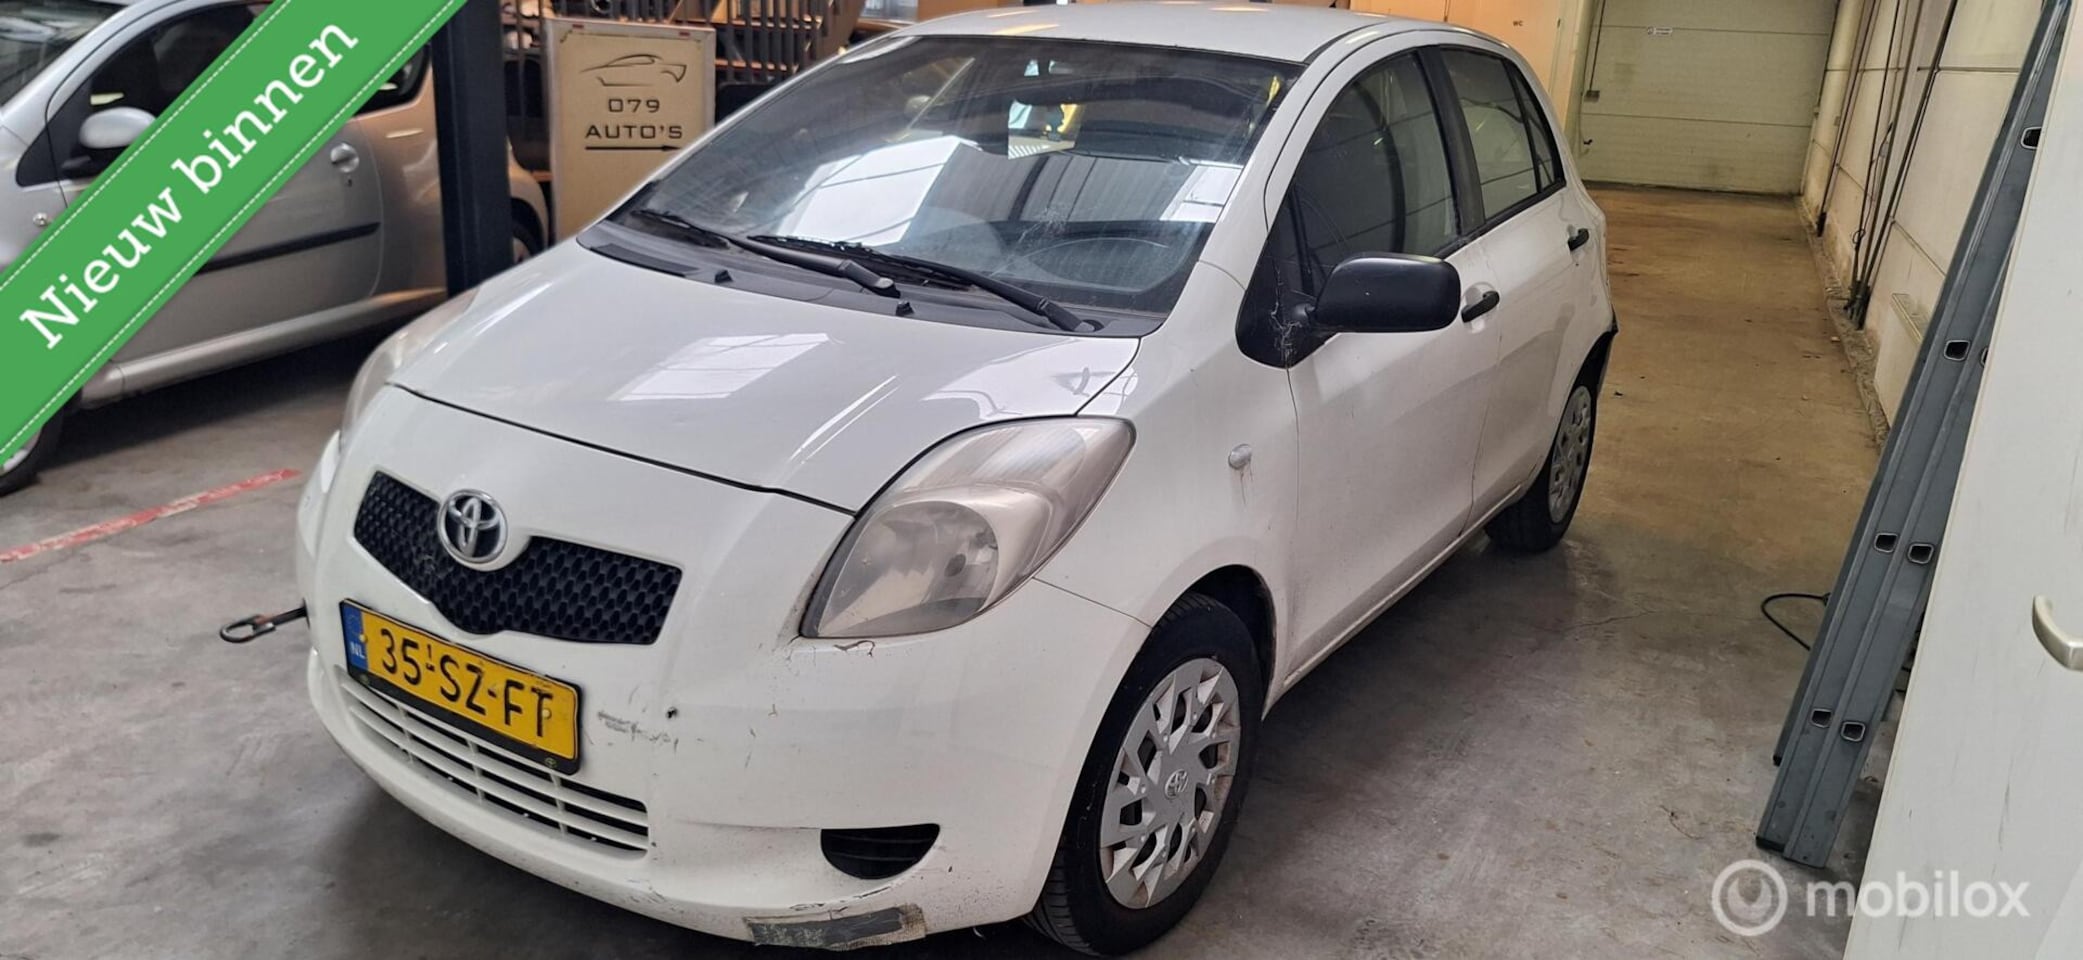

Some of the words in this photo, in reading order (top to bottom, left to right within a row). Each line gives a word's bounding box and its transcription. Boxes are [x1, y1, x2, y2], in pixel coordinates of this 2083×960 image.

[608, 98, 660, 113] 079
[585, 124, 683, 140] AUTO'S
[350, 640, 366, 660] NL
[380, 628, 553, 738] 35-SZ-FT
